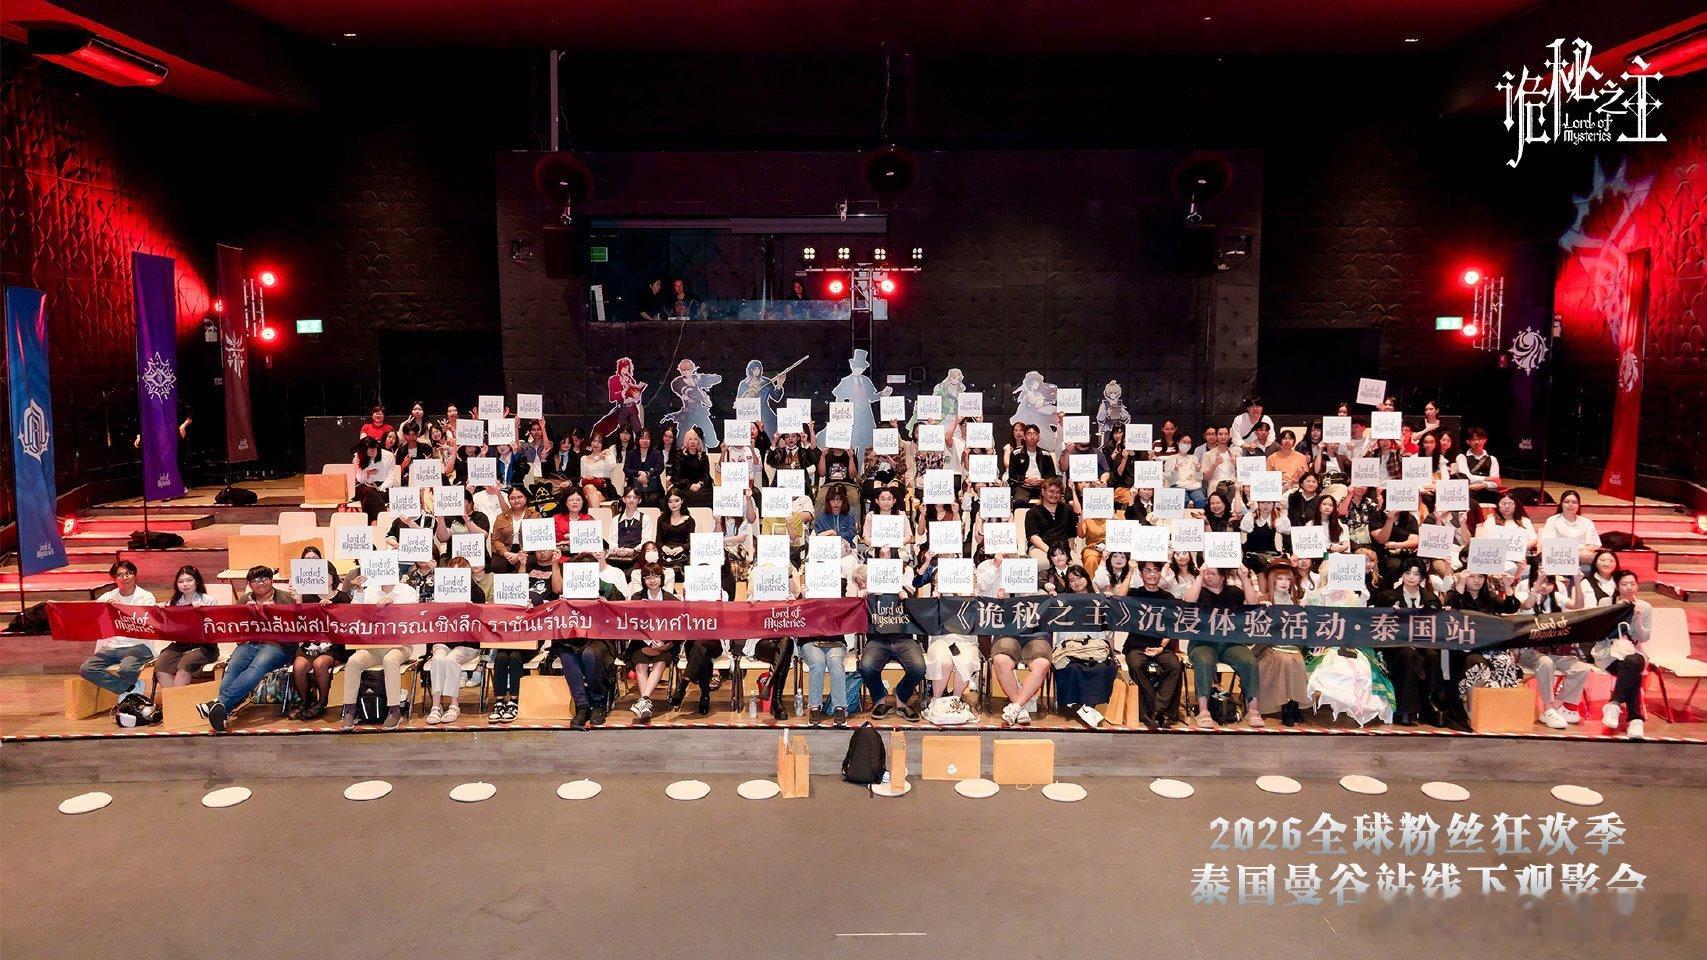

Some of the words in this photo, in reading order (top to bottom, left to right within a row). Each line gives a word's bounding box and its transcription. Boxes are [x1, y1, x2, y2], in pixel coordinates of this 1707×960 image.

[443, 576, 456, 586] Lord
[438, 584, 468, 596] Mysteries
[771, 606, 790, 619] Lord
[791, 605, 801, 619] of
[877, 600, 894, 615] Lord
[137, 611, 149, 626] of
[203, 610, 481, 636] กิจกรรมสัมผัสประสบการณ์เชิงลึก
[488, 607, 592, 633] ราชันเร้นลับ
[616, 612, 718, 631] ประเทศไทย
[764, 617, 806, 631] Mysteries
[871, 613, 910, 627] Mysteries
